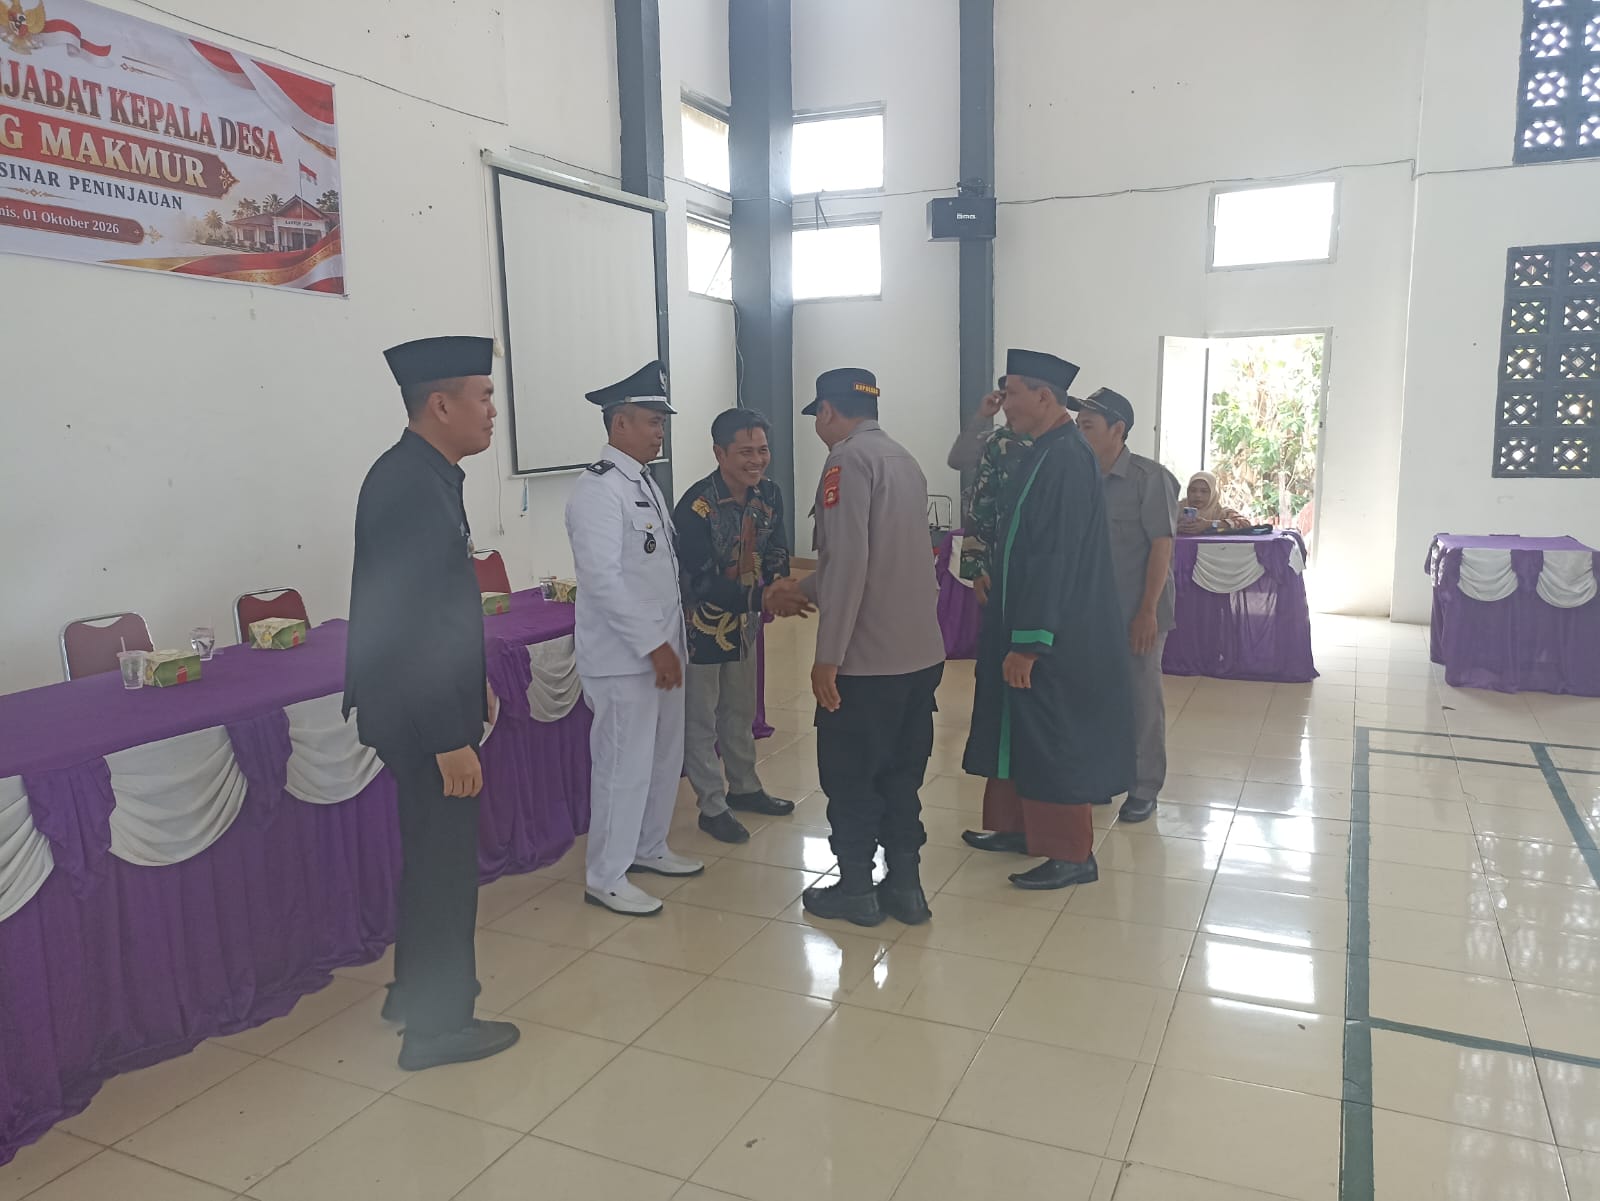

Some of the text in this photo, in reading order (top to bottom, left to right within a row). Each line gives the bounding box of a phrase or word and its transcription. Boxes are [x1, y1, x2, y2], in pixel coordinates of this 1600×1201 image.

[0, 58, 283, 164] JABAT KEPALA DESA
[38, 121, 207, 188] MAKMUR
[0, 161, 182, 210] SINAR PENINJAUAN
[23, 208, 37, 221] 01
[41, 211, 89, 229] Oktober
[92, 220, 120, 234] 2026
